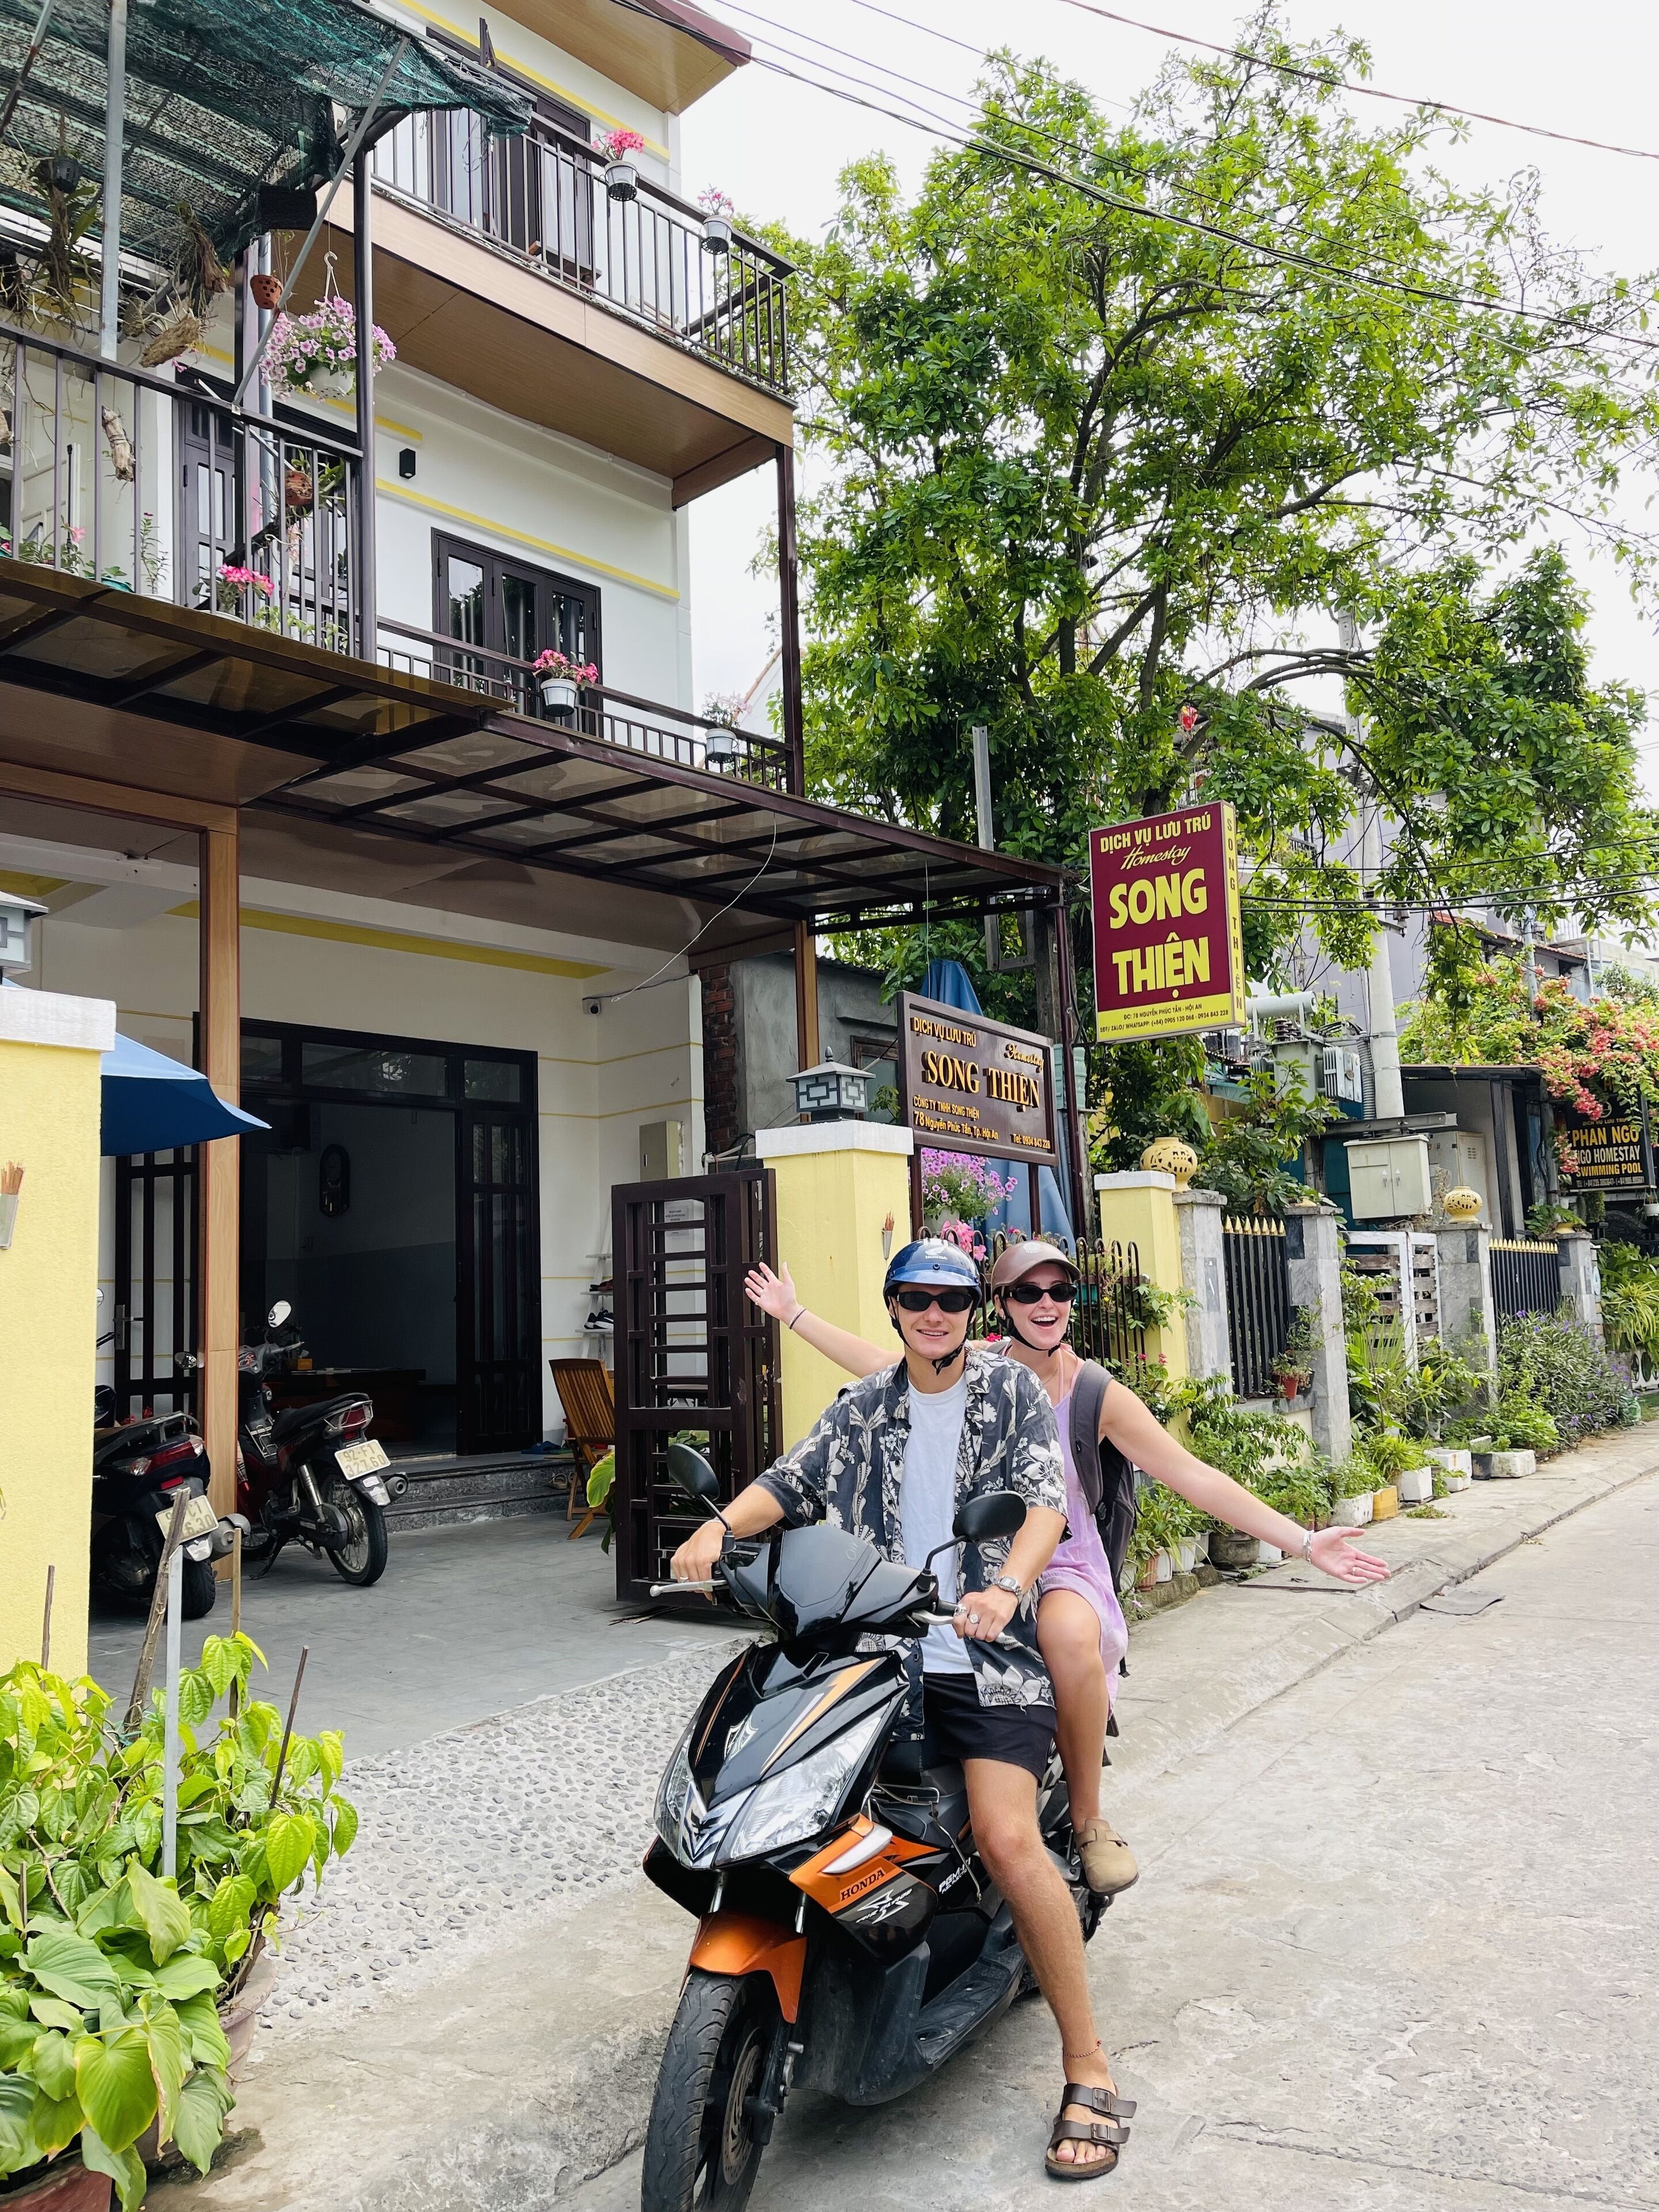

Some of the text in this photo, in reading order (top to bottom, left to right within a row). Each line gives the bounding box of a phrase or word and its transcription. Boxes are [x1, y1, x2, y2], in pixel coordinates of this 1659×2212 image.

[1100, 811, 1211, 854] DỊCH VỤ LƯU TRÚ
[1120, 844, 1192, 870] Homestay
[1109, 868, 1207, 930] SONG
[1112, 931, 1210, 999] THIỆN
[914, 1017, 976, 1047] DỊCH VỤ LƯU TRÚ
[1152, 1019, 1164, 1027] (+84)
[1007, 1043, 1044, 1073] Homestay
[926, 1050, 1040, 1112] SONG THIỆN
[914, 1094, 979, 1121] CÔNG TY TNHH SONG THIỆN
[914, 1111, 925, 1127] 78
[925, 1116, 946, 1132] Nguyễn
[947, 1121, 960, 1133] Phúc
[974, 1126, 982, 1139] Tp.
[982, 1127, 991, 1140] Hội
[991, 1129, 999, 1140] An
[1572, 1127, 1607, 1147] PHAN
[1593, 1145, 1641, 1163] HOMESTAY
[1576, 1162, 1643, 1177] SWIMMING POOL
[343, 1444, 376, 1462] 92-F1
[840, 1869, 885, 1902] HONDA
